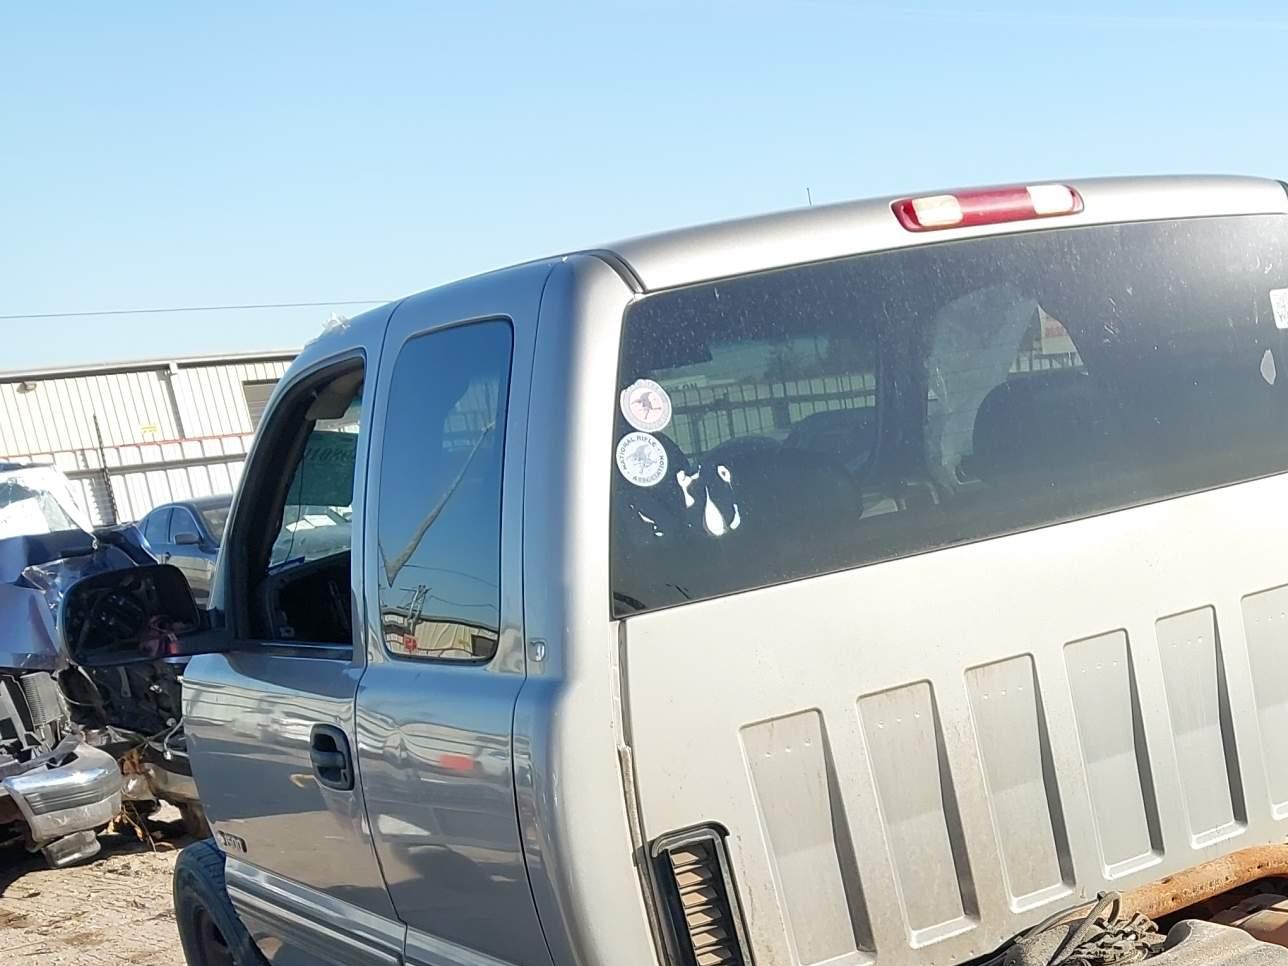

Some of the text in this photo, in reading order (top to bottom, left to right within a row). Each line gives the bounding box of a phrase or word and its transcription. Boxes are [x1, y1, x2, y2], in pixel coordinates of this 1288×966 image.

[619, 435, 657, 471] NATIONAL RIFLE
[632, 455, 665, 484] ASSOCIATION
